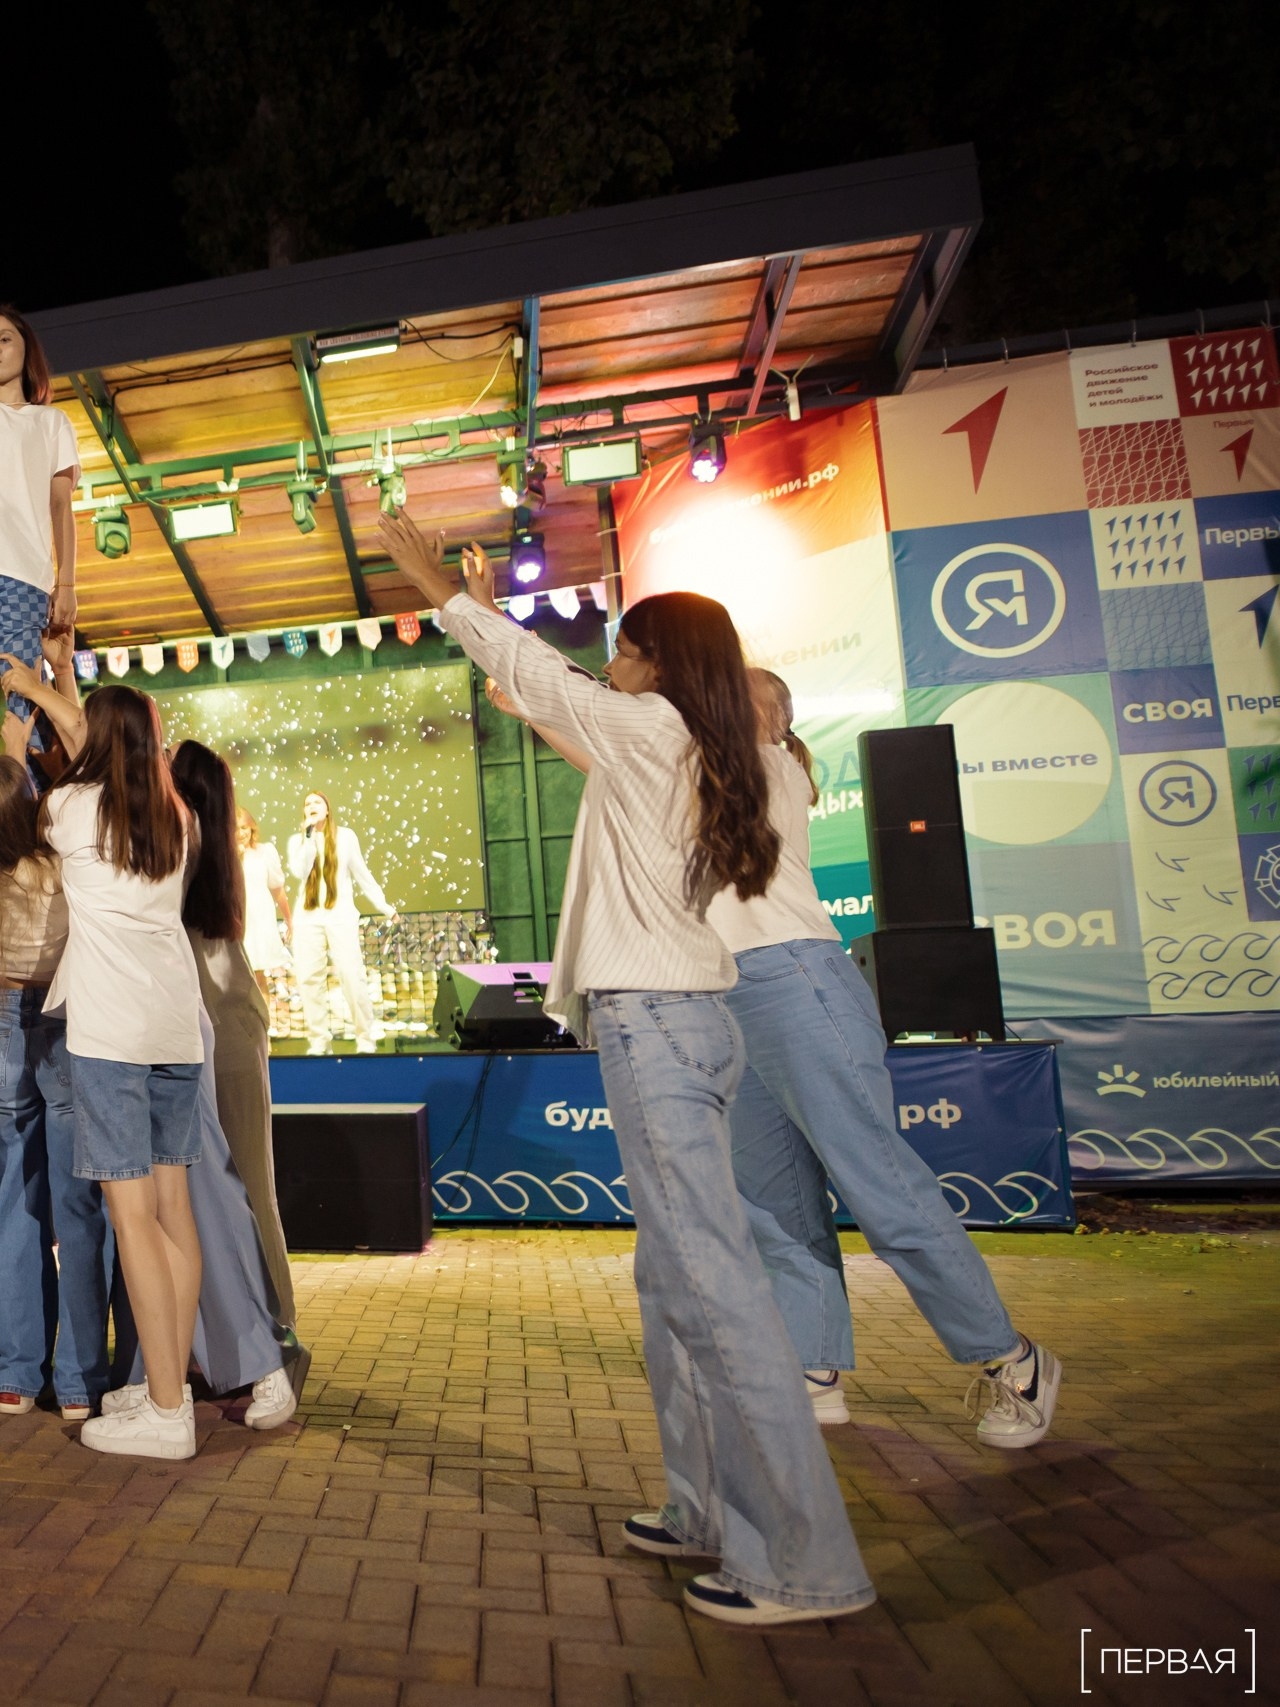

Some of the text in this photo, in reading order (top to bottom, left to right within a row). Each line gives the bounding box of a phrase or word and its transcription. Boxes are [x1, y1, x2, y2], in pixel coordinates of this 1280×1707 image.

[1085, 363, 1159, 376] Российское
[1086, 374, 1149, 388] движение
[1088, 386, 1124, 398] детей
[1089, 400, 1097, 408] и
[1213, 418, 1255, 430] Первые
[991, 753, 1099, 773] вместе
